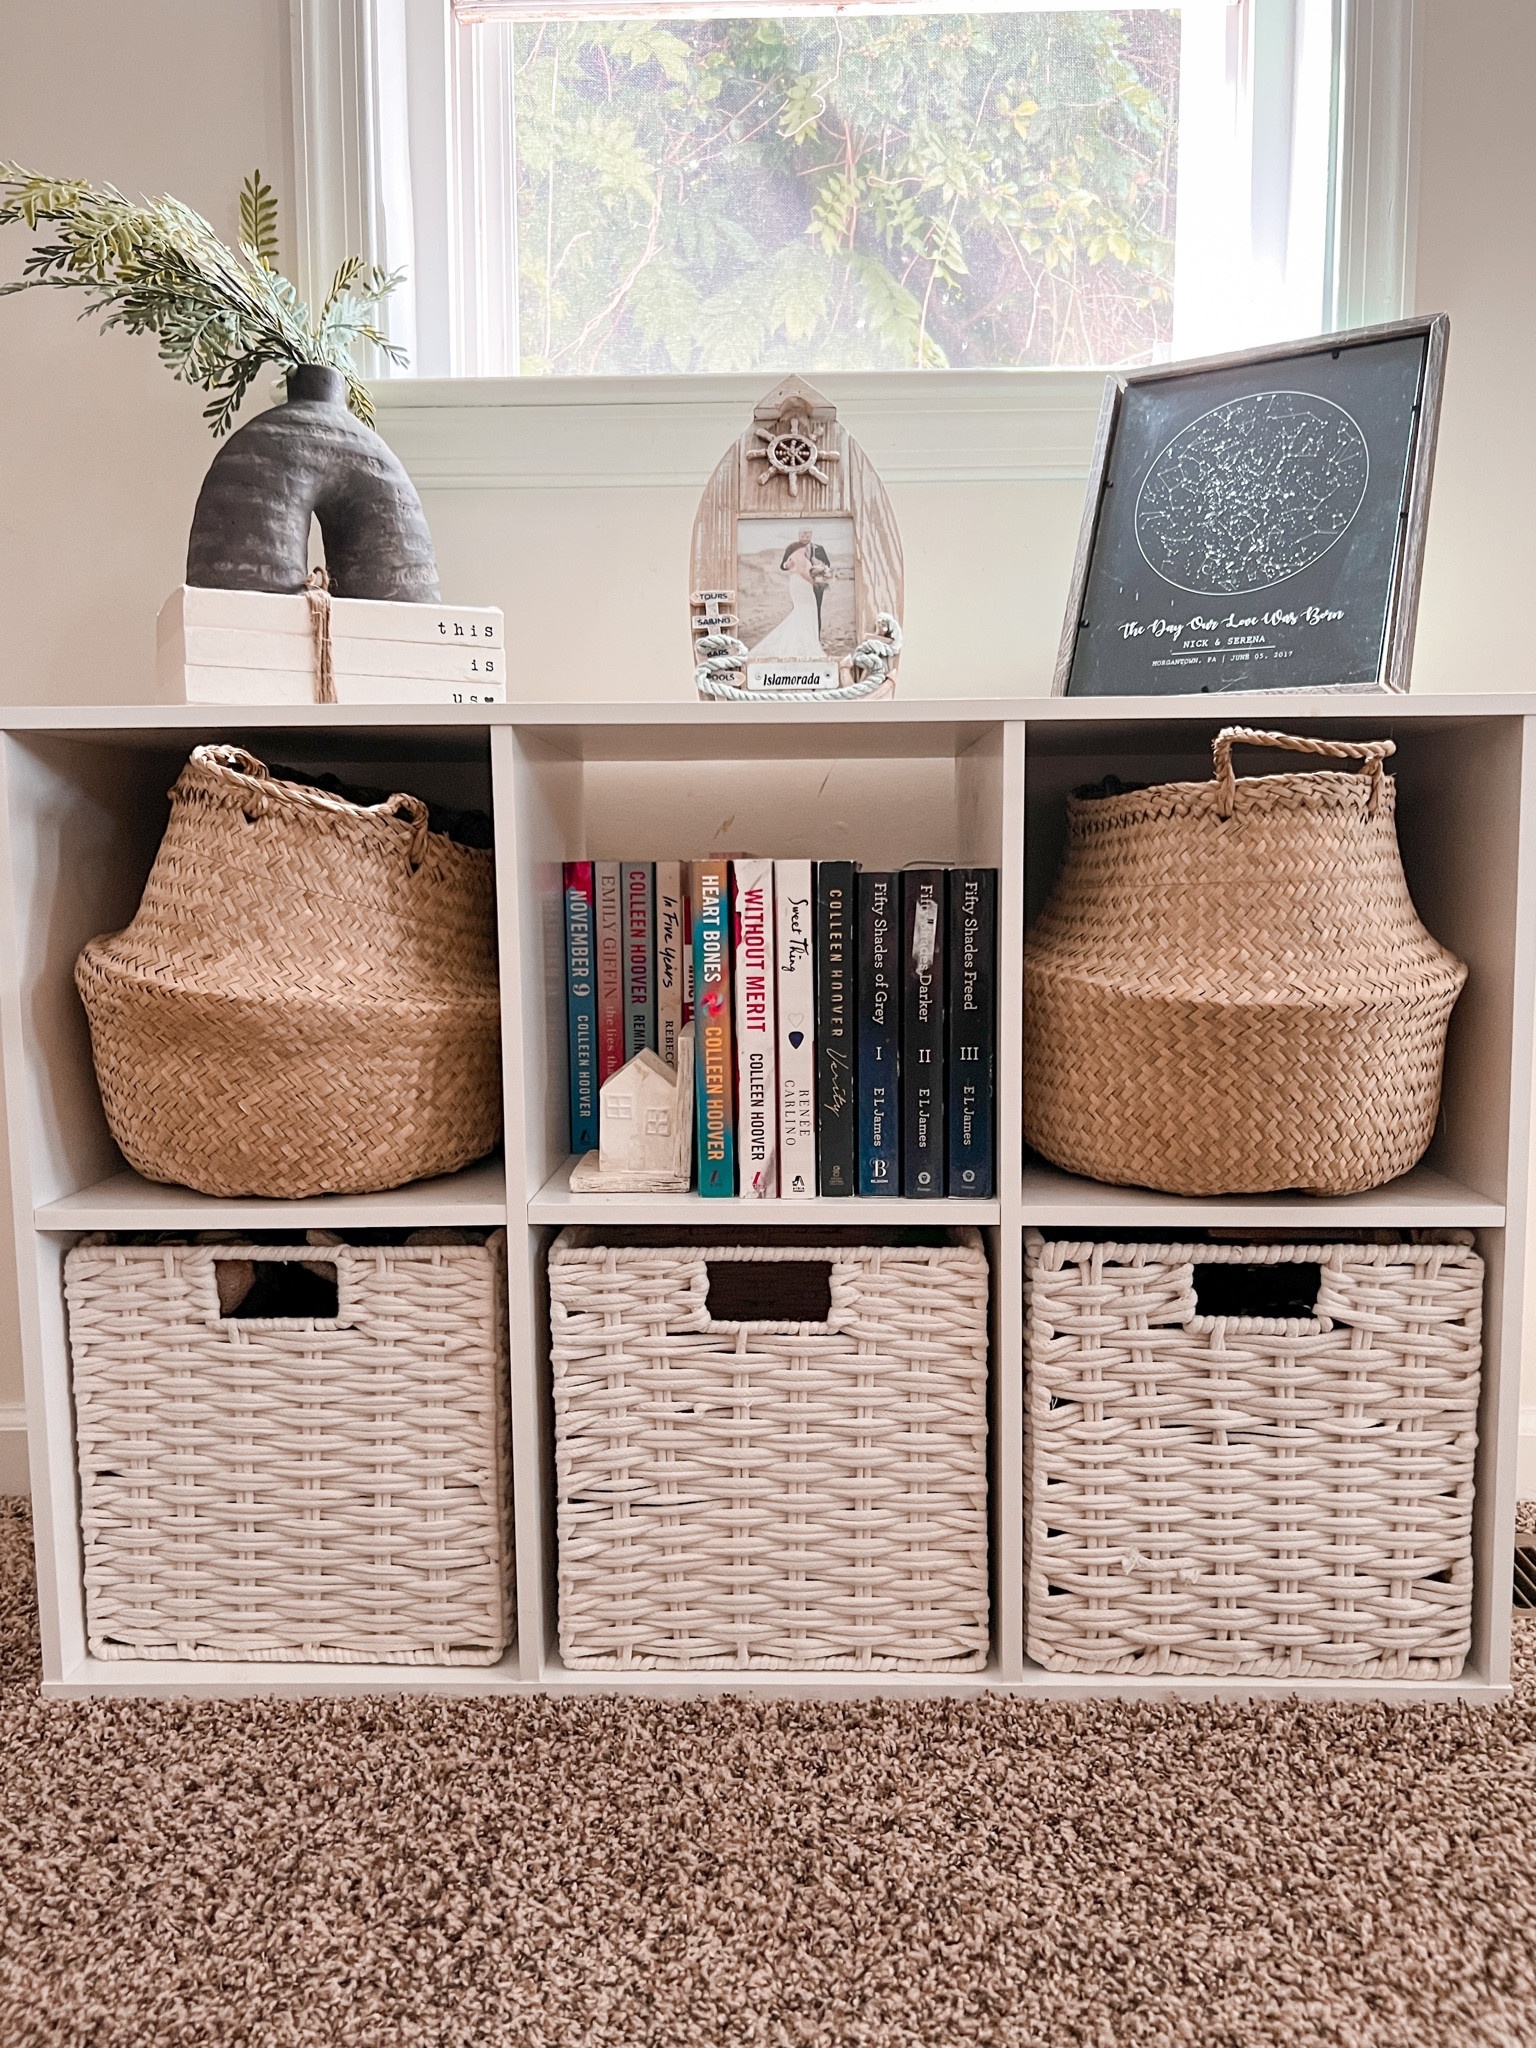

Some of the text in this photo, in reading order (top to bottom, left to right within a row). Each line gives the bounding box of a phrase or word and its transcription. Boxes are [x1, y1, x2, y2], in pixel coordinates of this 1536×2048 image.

[437, 621, 493, 637] this
[1147, 619, 1184, 641] Day
[1186, 616, 1219, 631] Our
[1220, 612, 1259, 628] Love
[1261, 609, 1298, 626] Was
[1300, 606, 1345, 626] Born
[1182, 635, 1266, 649] NICK & SERENA
[471, 659, 494, 672] is
[763, 672, 820, 686] Islamorada
[1230, 653, 1250, 662] JUNE
[569, 890, 590, 997] NOVEMBER 9
[601, 876, 618, 999] EMILY GIFFIN
[629, 871, 647, 1004] COLLEEN HOOVER
[659, 895, 679, 988] In Five Years
[701, 875, 722, 983] HEART BONES
[744, 888, 766, 1033] WITHOUT MERIT
[781, 897, 809, 972] Sweet Thing
[871, 882, 889, 1026] Fifty Shades of Grey
[961, 881, 979, 1011] Fifty Shades Freed
[829, 889, 843, 1037] COLLEEN HOOVER
[918, 974, 933, 1023] Darker
[577, 1015, 591, 1117] COLLEEN HOOVER
[606, 1006, 618, 1075] the lies tha
[633, 1015, 646, 1056] REMIN
[665, 1020, 675, 1069] REBECC
[875, 1046, 883, 1061] I
[918, 1049, 932, 1063] II
[959, 1046, 979, 1061] III
[705, 1027, 725, 1161] COLLEEN HOOVER
[749, 1053, 765, 1161] COLLEEN HOOVER
[784, 1079, 797, 1146] CARLINO
[823, 1047, 849, 1118] Verity
[963, 1085, 975, 1146] E L James
[873, 1087, 885, 1147] E L James
[918, 1088, 930, 1148] E L James
